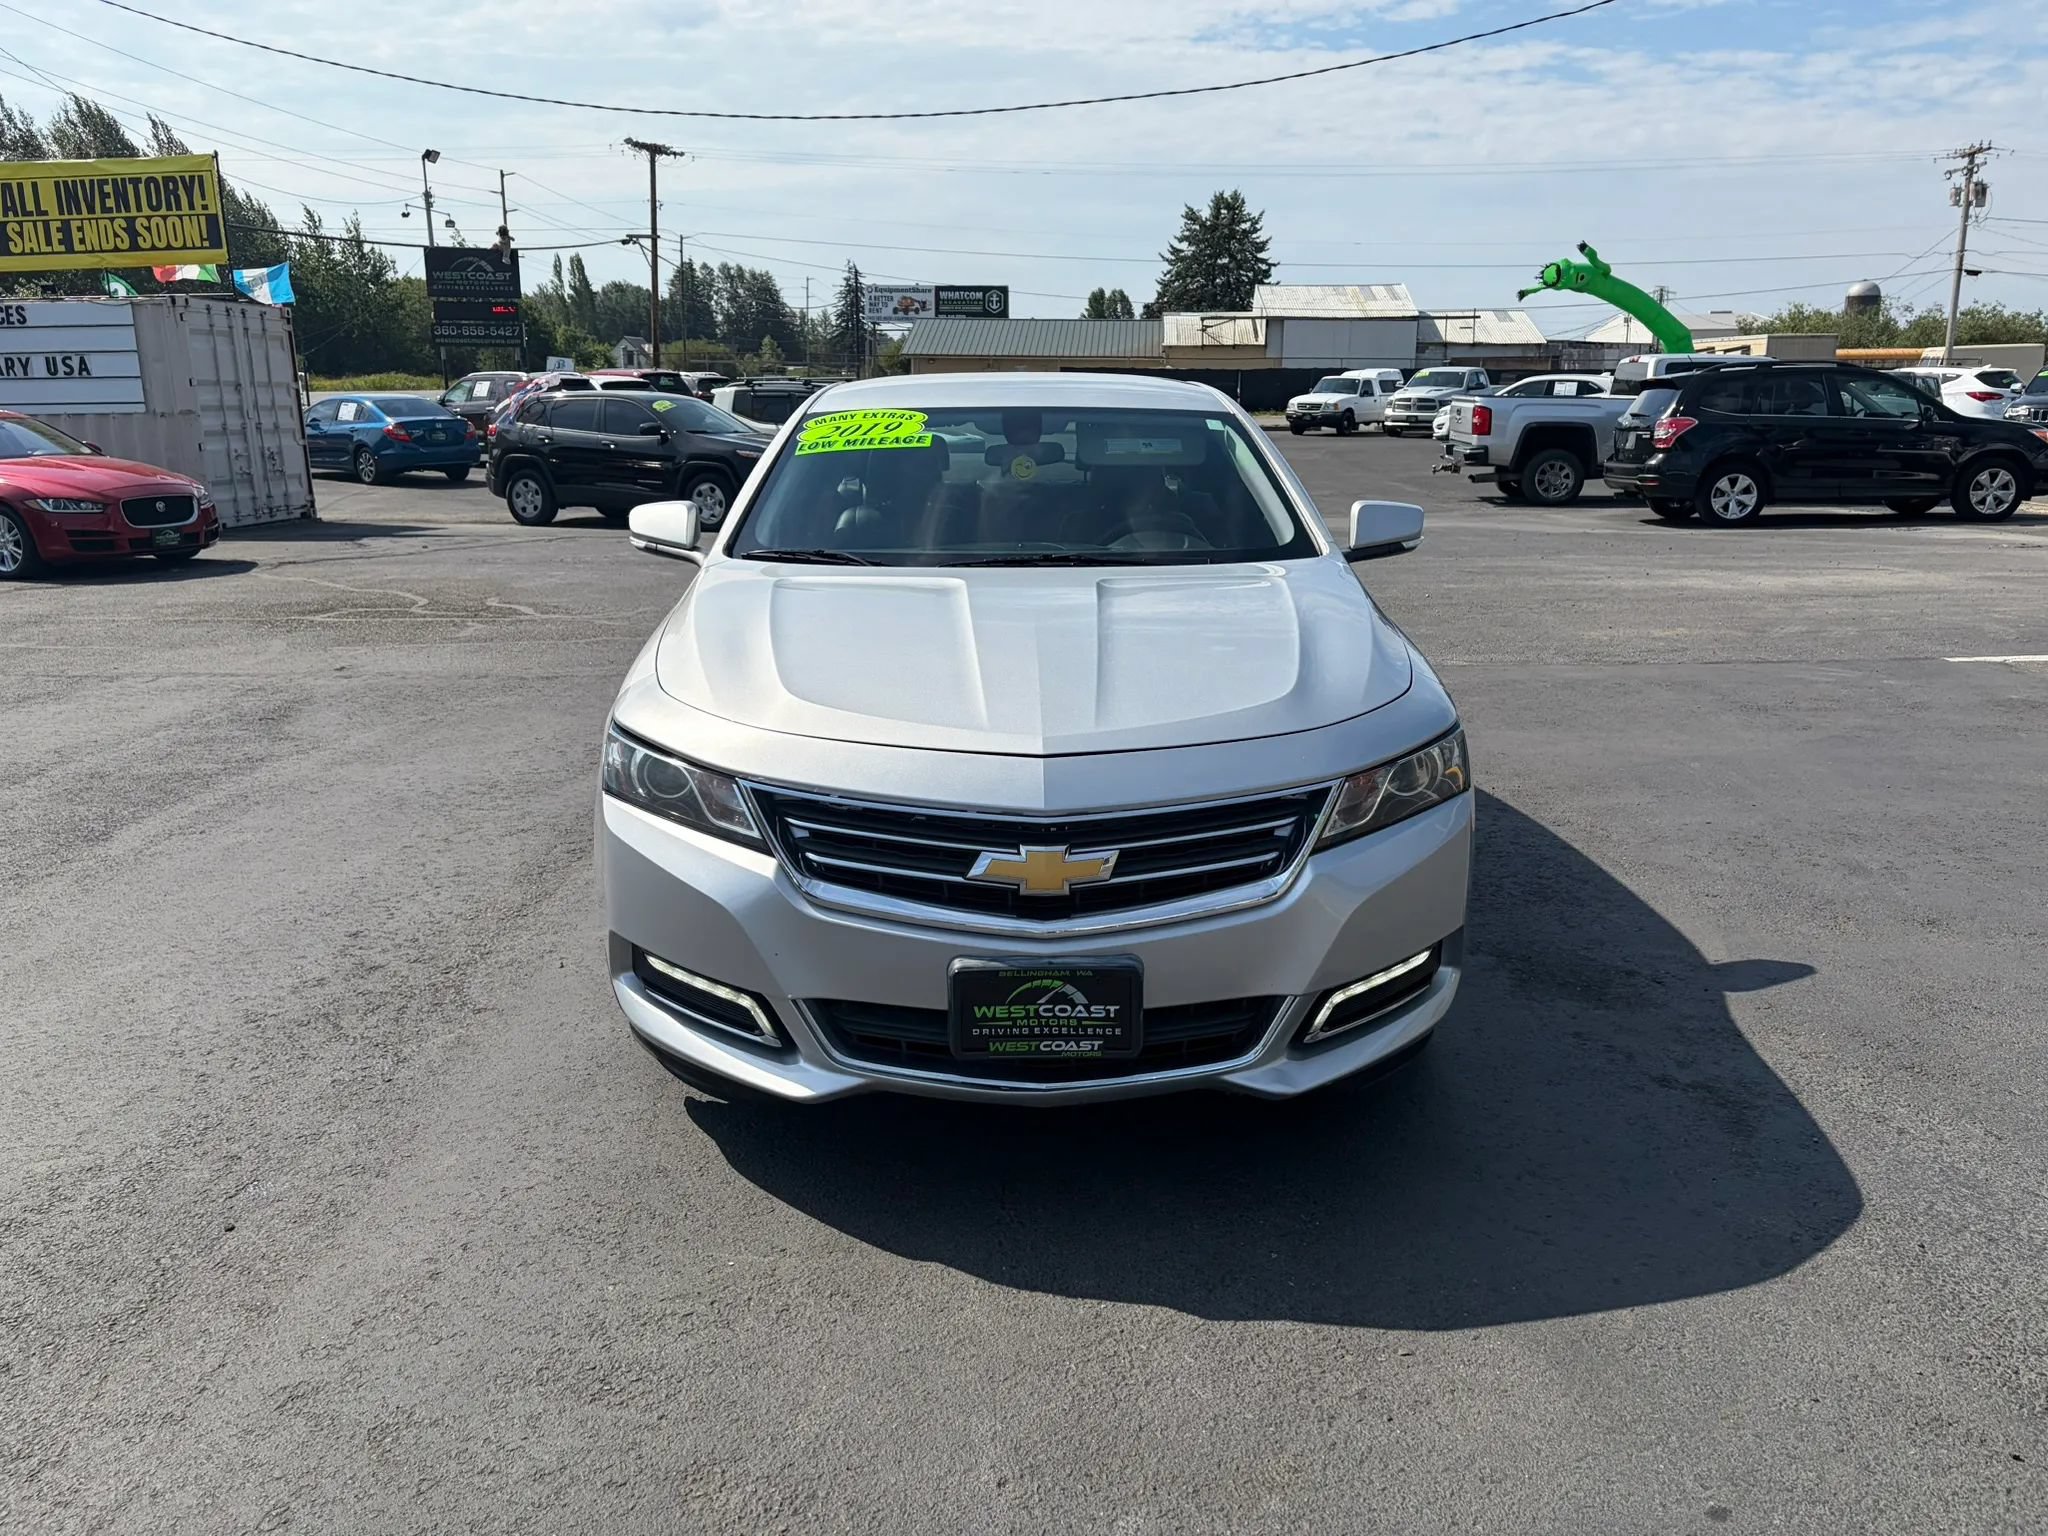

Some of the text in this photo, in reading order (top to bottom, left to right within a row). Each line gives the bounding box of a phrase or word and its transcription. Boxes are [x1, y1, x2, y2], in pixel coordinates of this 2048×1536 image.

[1, 174, 209, 218] ALL INVENTORY!
[6, 215, 209, 254] SALE ENDS SOON!
[432, 271, 512, 280] WESTCOAST
[874, 286, 932, 294] EquipmentShare
[939, 291, 983, 300] WHATCOM
[433, 325, 520, 336] 360-656-5427
[0, 355, 92, 377] RY USA
[814, 412, 917, 426] MANY EXTRAS
[816, 421, 903, 440] 2019
[798, 435, 930, 452] LOW MILEAGE
[973, 1004, 1121, 1018] WESTCOAST
[1016, 1018, 1078, 1027] MOTORS
[972, 1027, 1122, 1036] DRIVING EXCELLENCE
[988, 1040, 1104, 1052] WESTCOAST
